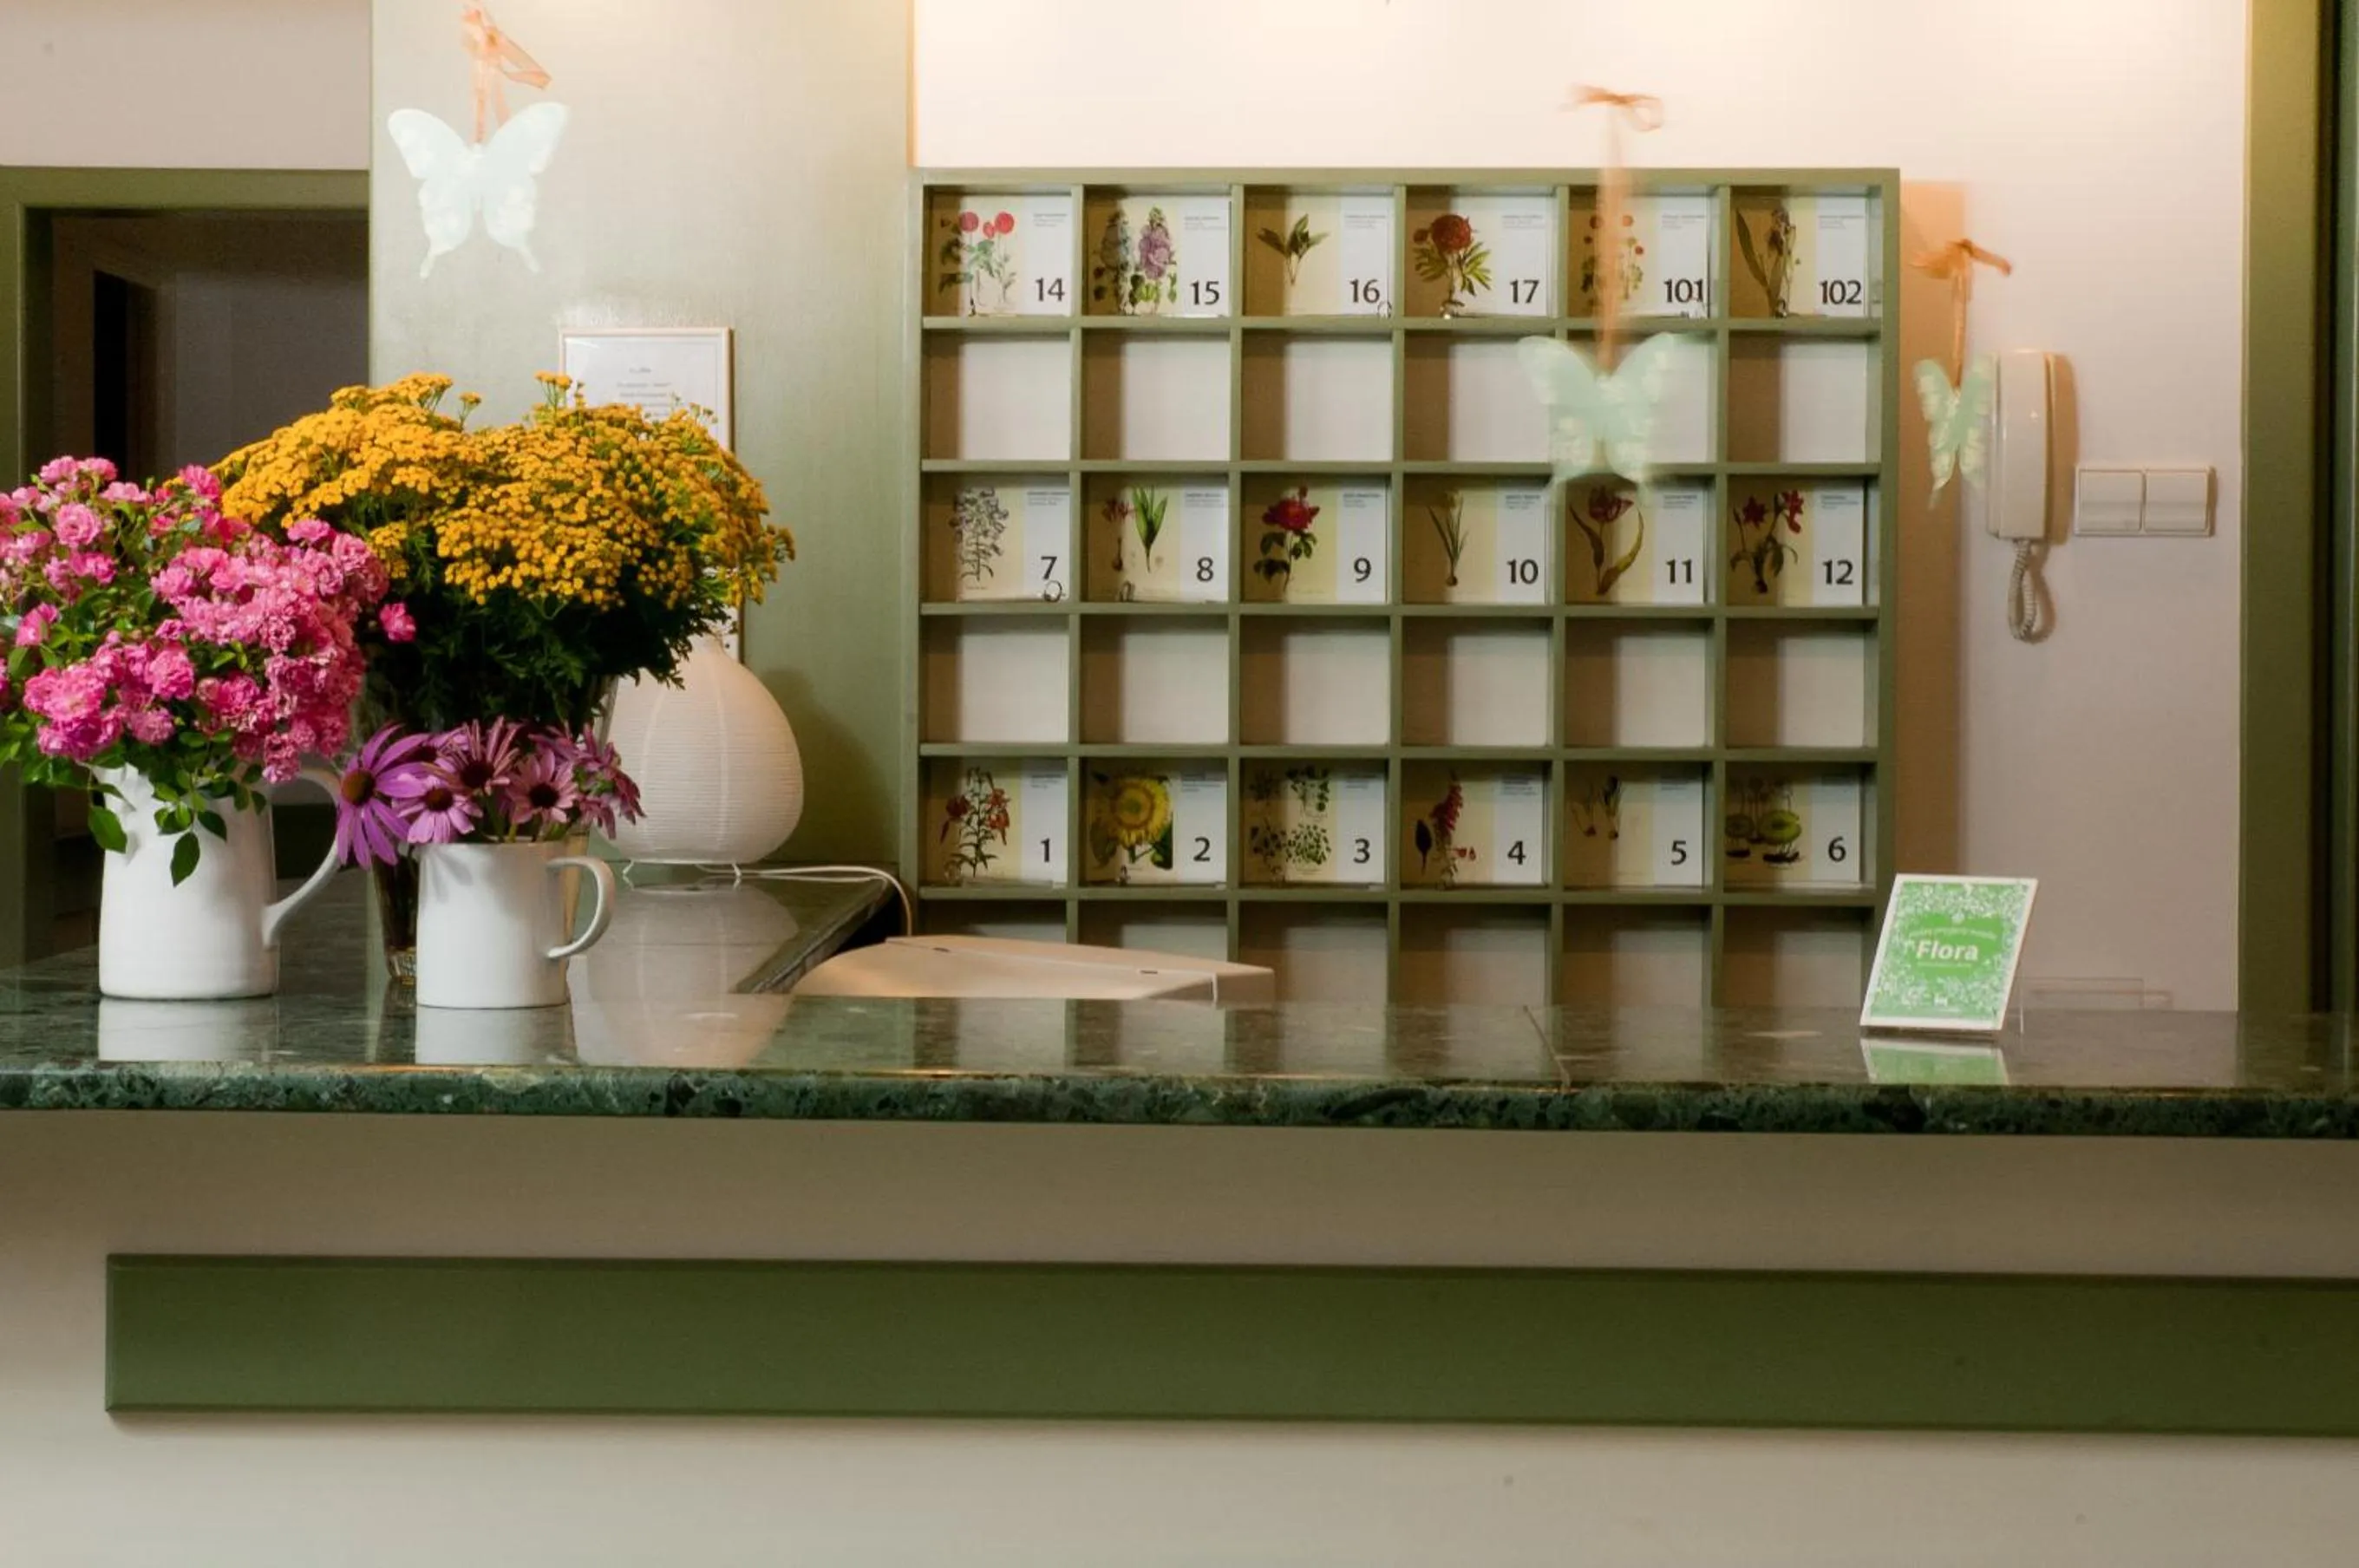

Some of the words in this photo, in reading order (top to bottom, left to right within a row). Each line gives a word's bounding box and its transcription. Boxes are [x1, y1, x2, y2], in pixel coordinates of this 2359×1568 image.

[1036, 278, 1065, 302] 14
[1192, 281, 1219, 305] 15
[1350, 279, 1381, 304] 16
[1510, 279, 1539, 304] 17
[1664, 278, 1703, 303] 101
[1820, 280, 1862, 305] 102
[1041, 556, 1058, 580] 7
[1196, 557, 1214, 582] 8
[1353, 558, 1372, 583] 9
[1507, 559, 1539, 585] 10
[1666, 559, 1692, 584] 11
[1823, 559, 1853, 585] 12
[1041, 838, 1050, 863] 1
[1193, 837, 1211, 862] 2
[1353, 838, 1370, 864] 3
[1507, 840, 1526, 866] 4
[1671, 840, 1687, 866] 5
[1827, 836, 1846, 862] 6
[1915, 939, 1979, 962] Flora
